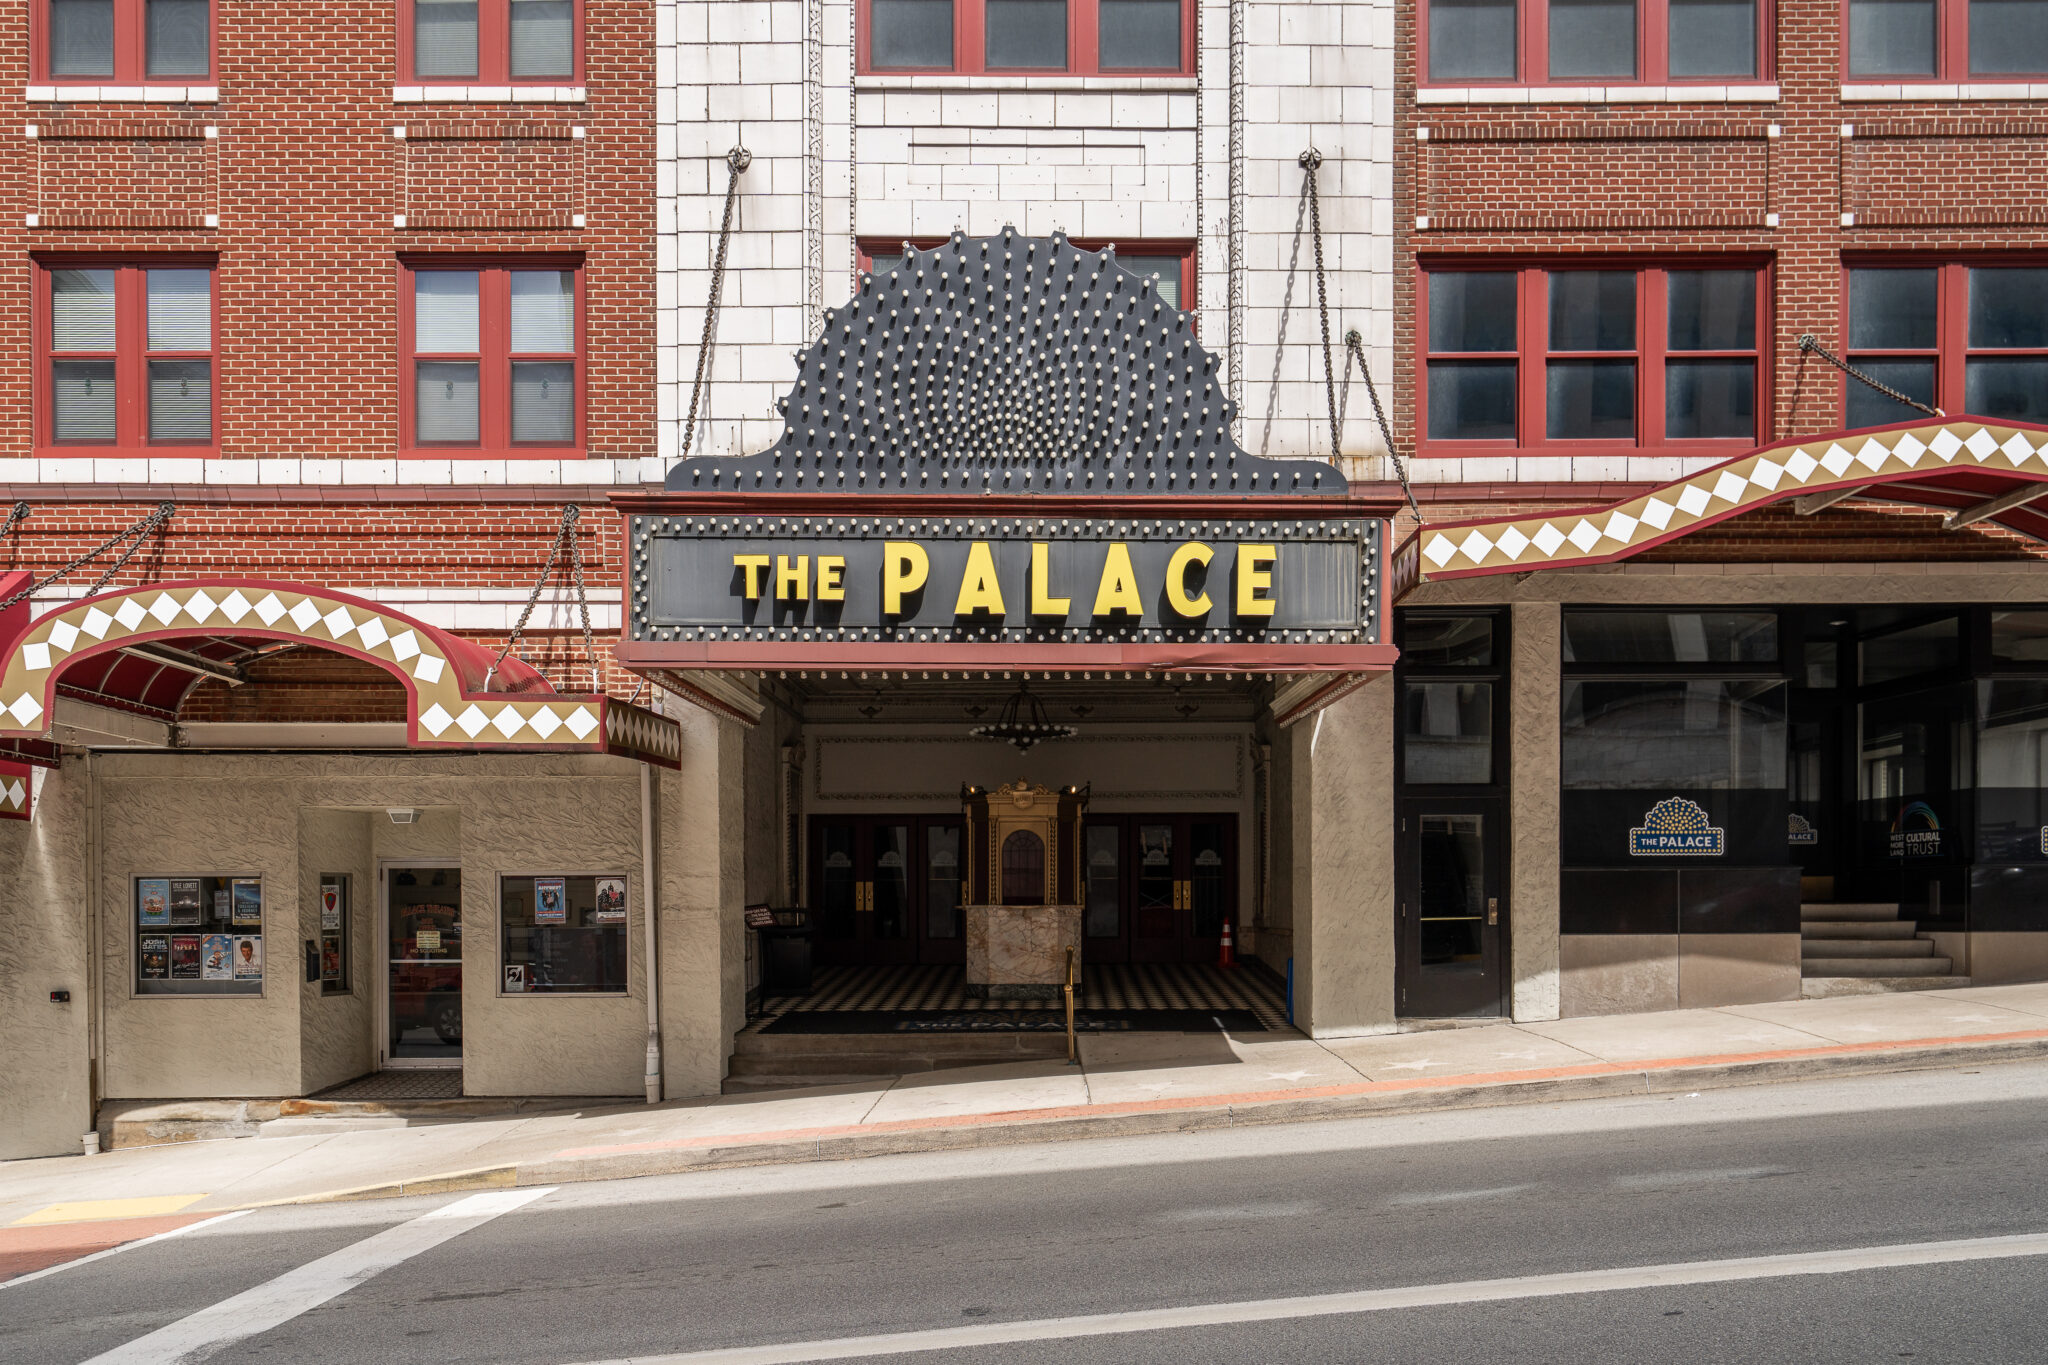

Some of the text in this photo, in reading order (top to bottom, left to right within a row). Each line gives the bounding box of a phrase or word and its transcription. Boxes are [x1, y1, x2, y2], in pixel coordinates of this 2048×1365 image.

[733, 541, 1278, 618] THE PALACE
[1641, 836, 1712, 847] THE PALACE
[1906, 832, 1940, 842] CULTURAL
[1906, 842, 1940, 855] TRUST
